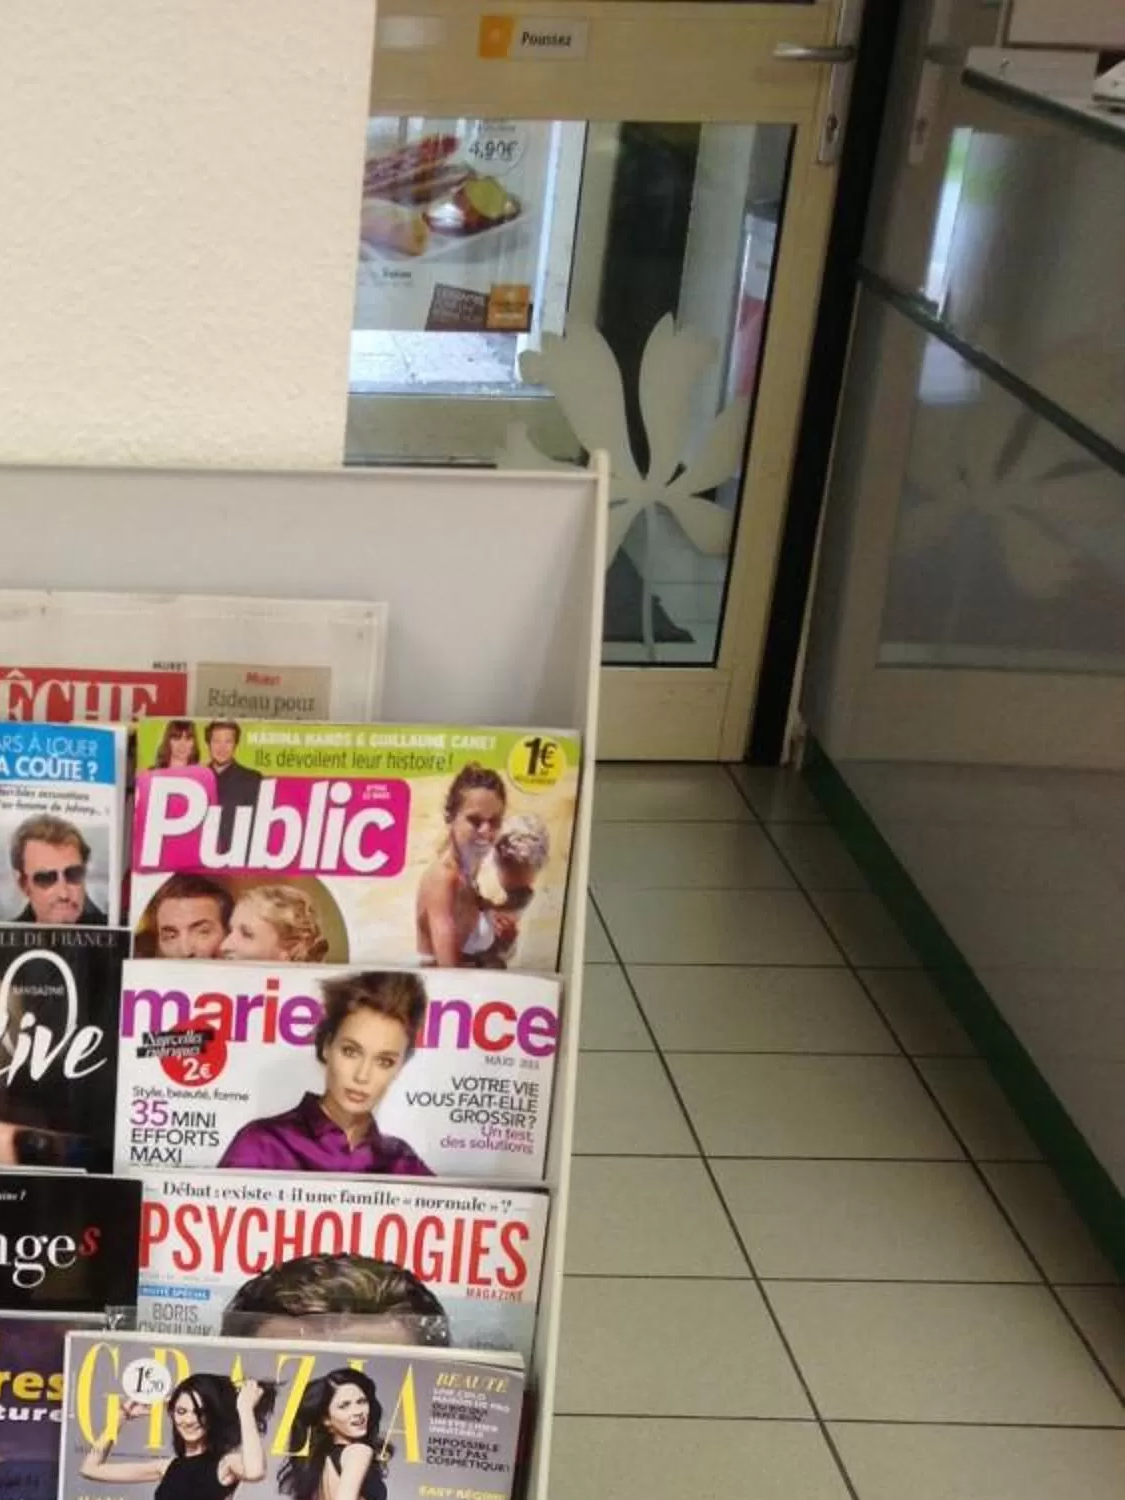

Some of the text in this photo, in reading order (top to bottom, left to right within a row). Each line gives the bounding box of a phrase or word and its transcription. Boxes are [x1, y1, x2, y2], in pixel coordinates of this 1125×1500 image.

[208, 688, 315, 716] Rideau pour
[28, 733, 42, 753] À
[47, 736, 98, 757] LOUER
[15, 752, 81, 779] COÛTE
[255, 752, 272, 767] Ils
[277, 751, 347, 769] dévoilent
[352, 752, 382, 769] leur
[141, 776, 395, 872] Public
[51, 930, 117, 947] FRANCE
[120, 978, 323, 1047] marie
[182, 1058, 213, 1081] 2€
[451, 1076, 539, 1097] VOTRE VIE
[130, 1099, 217, 1128] 35 MINI
[405, 1092, 539, 1114] VOUS FAIT-ELLE
[130, 1128, 220, 1147] EFFORTS
[481, 1126, 502, 1138] Un
[130, 1146, 183, 1164] MAXI
[439, 1135, 535, 1155] des solutions
[163, 1181, 211, 1197] Débat
[306, 1191, 337, 1204] une
[340, 1189, 401, 1206] famille
[414, 1196, 487, 1212] normale
[139, 1201, 530, 1289] PSYCHOLOGIES
[466, 1288, 525, 1303] MAGAZINE
[151, 1303, 199, 1322] BORIS
